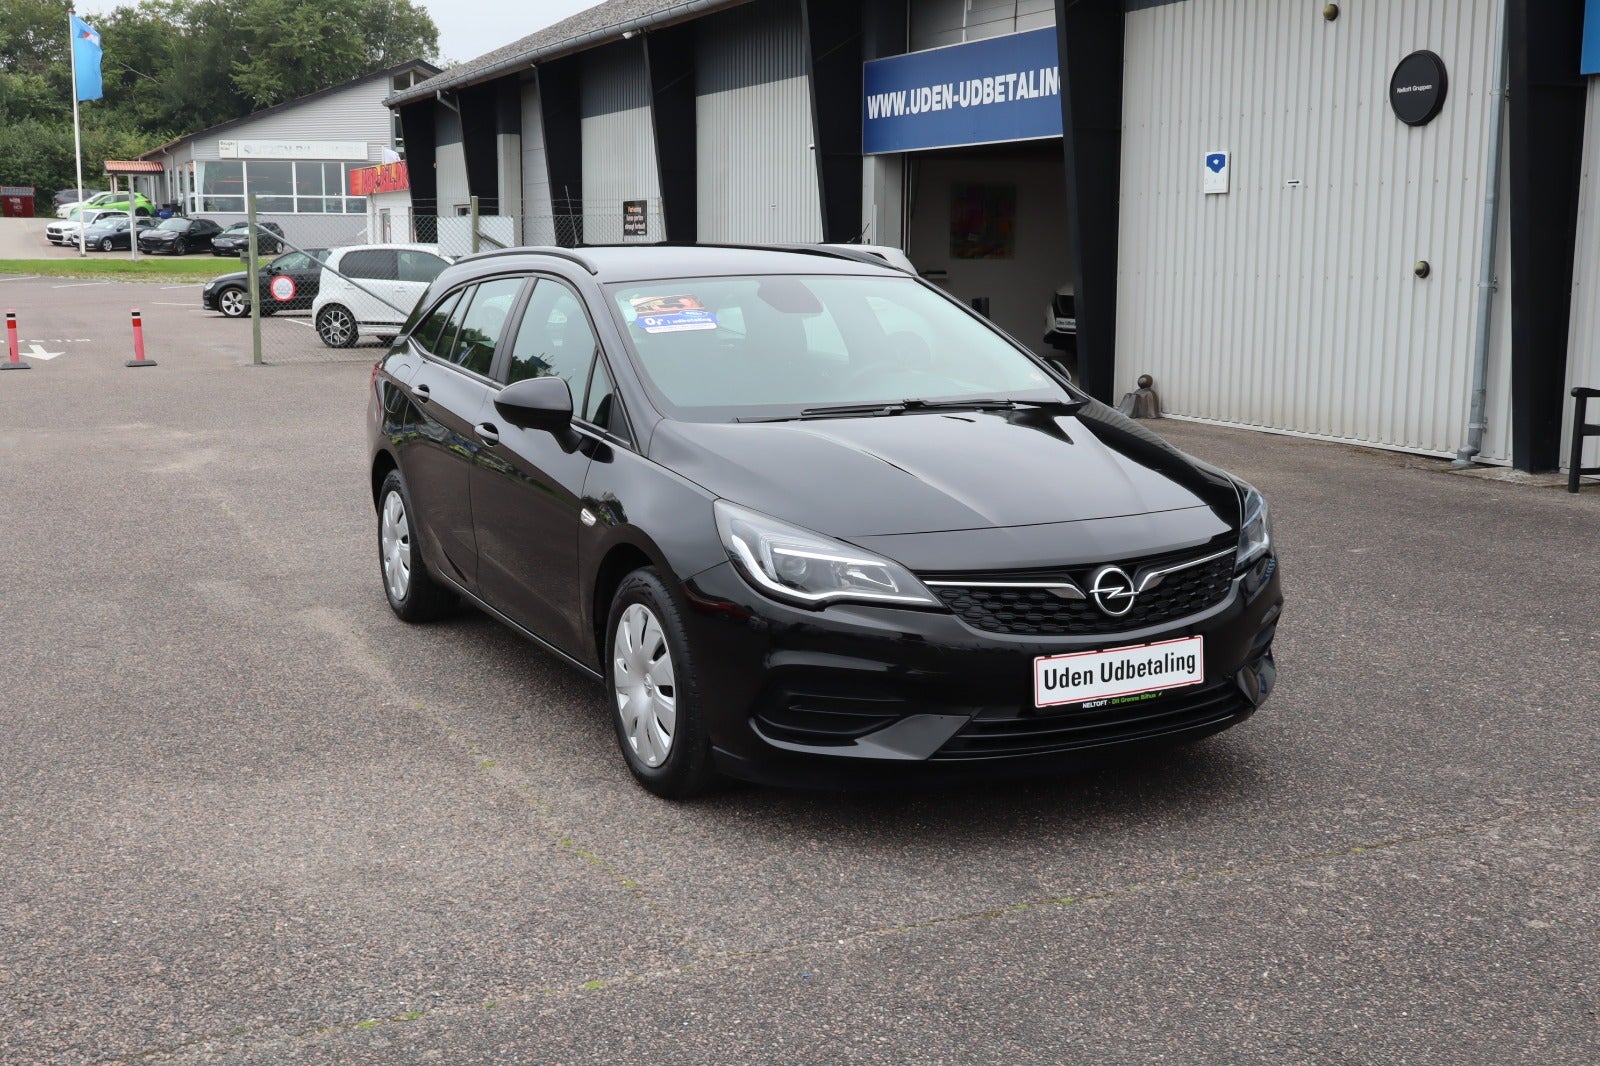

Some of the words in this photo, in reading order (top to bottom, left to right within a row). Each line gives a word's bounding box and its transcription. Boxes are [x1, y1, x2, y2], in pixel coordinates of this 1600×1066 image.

[867, 66, 1061, 119] WWW.UDEN-UDBETALIN
[1044, 667, 1093, 690] Uden
[1100, 652, 1196, 683] Udbetaling
[1082, 700, 1107, 709] NELTOFT
